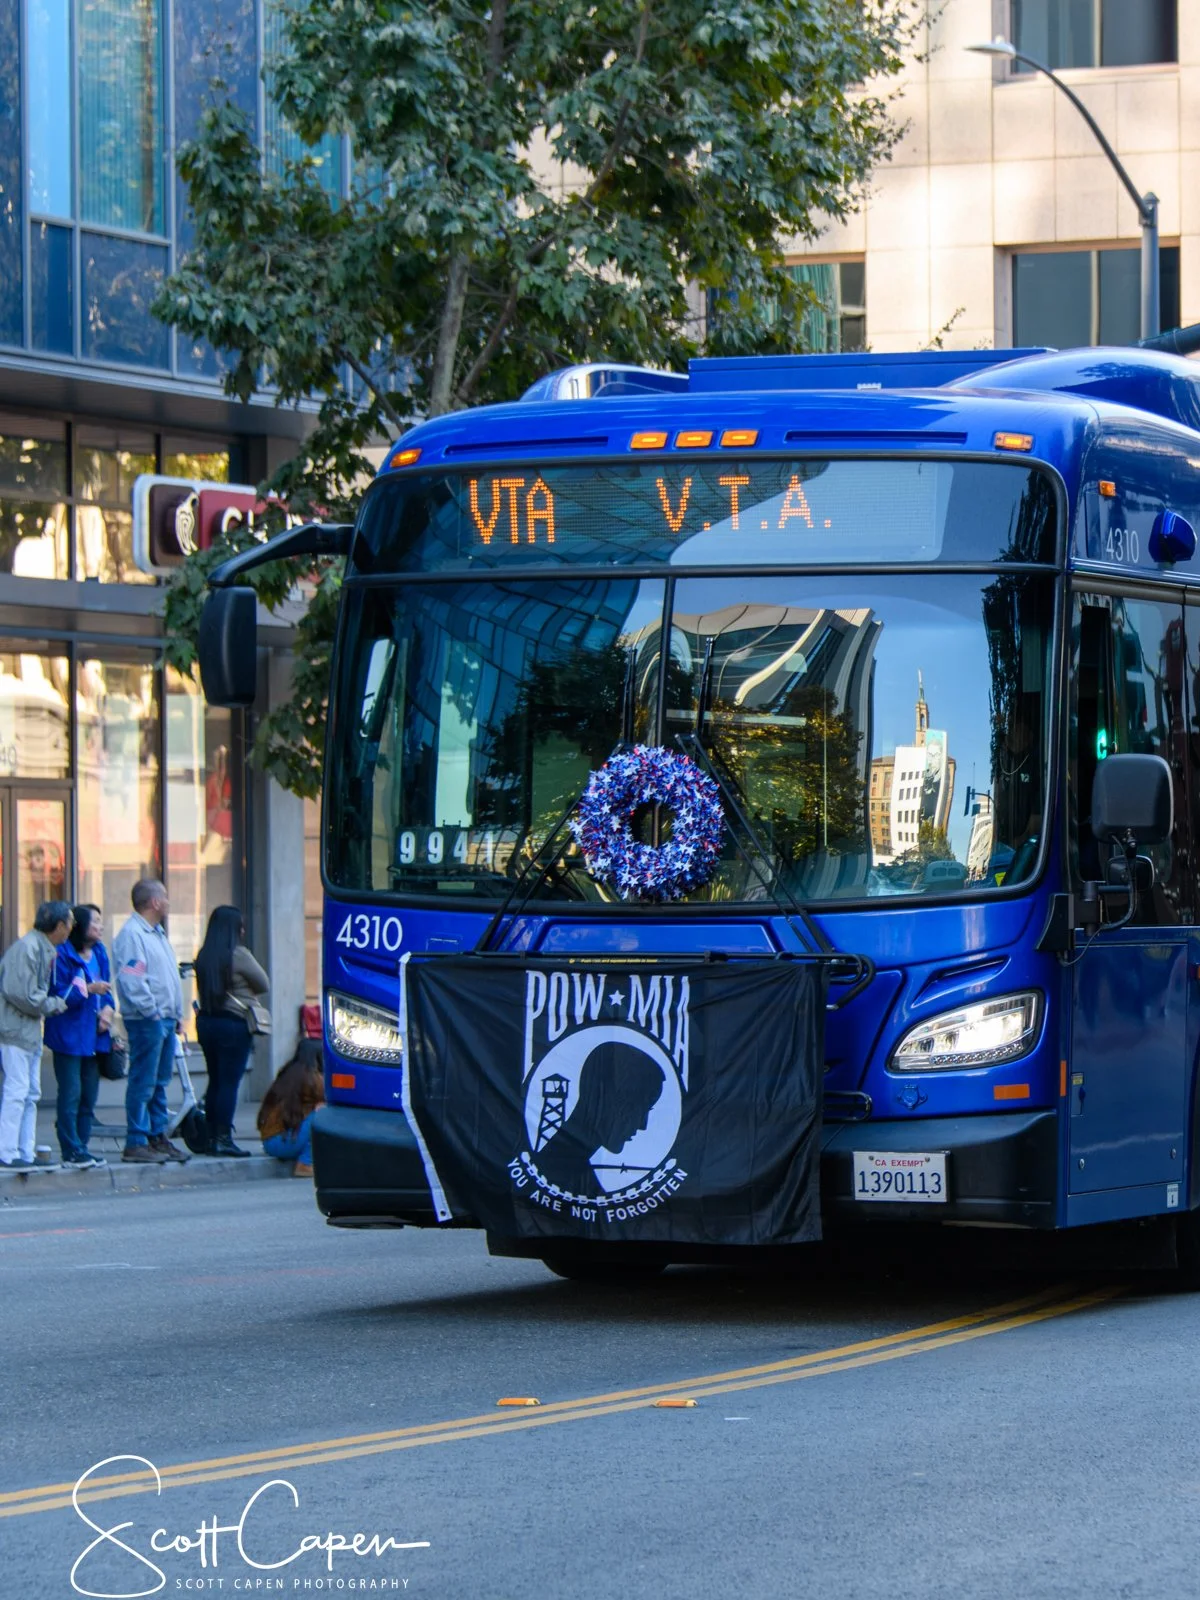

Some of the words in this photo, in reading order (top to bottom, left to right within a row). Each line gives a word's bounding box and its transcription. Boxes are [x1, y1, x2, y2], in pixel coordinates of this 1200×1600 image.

[469, 478, 555, 544] VTA
[655, 475, 832, 532] V.T.A.
[1105, 527, 1140, 564] 4310
[336, 913, 403, 951] 4310
[522, 970, 607, 1085] POW
[626, 974, 691, 1092] MIA
[858, 1170, 942, 1194] 1390113
[874, 1159, 887, 1167] CA
[507, 1157, 529, 1188] YOU
[530, 1190, 562, 1212] ARE
[571, 1206, 597, 1222] NOT
[606, 1168, 689, 1223] FORGOTTEN
